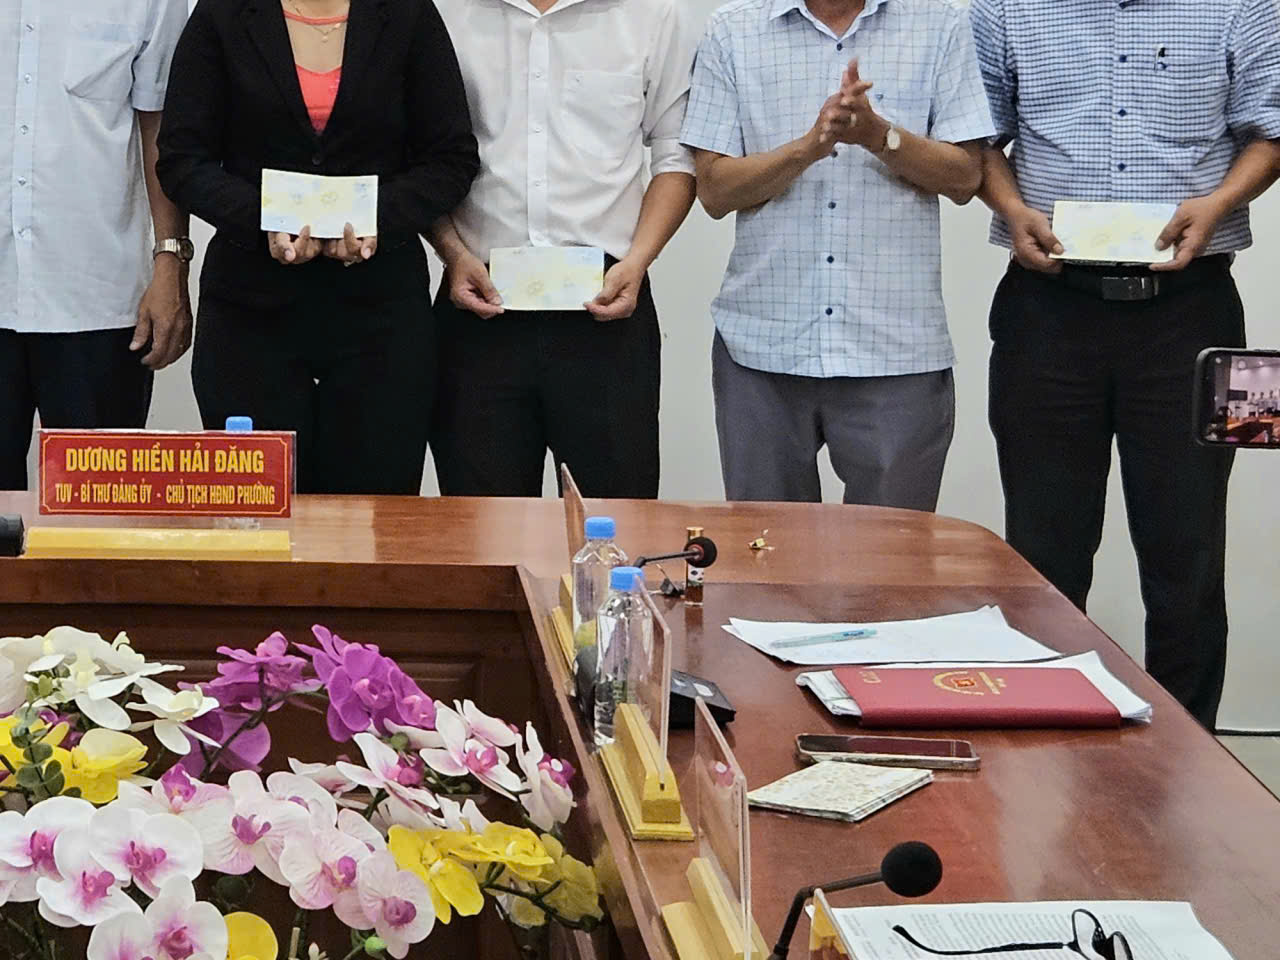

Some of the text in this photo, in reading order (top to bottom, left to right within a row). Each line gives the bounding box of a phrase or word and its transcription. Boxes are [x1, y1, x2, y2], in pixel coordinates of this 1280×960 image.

[65, 446, 127, 472] DƯƠNG
[180, 442, 210, 473] HẢI
[215, 445, 265, 473] ĐĂNG
